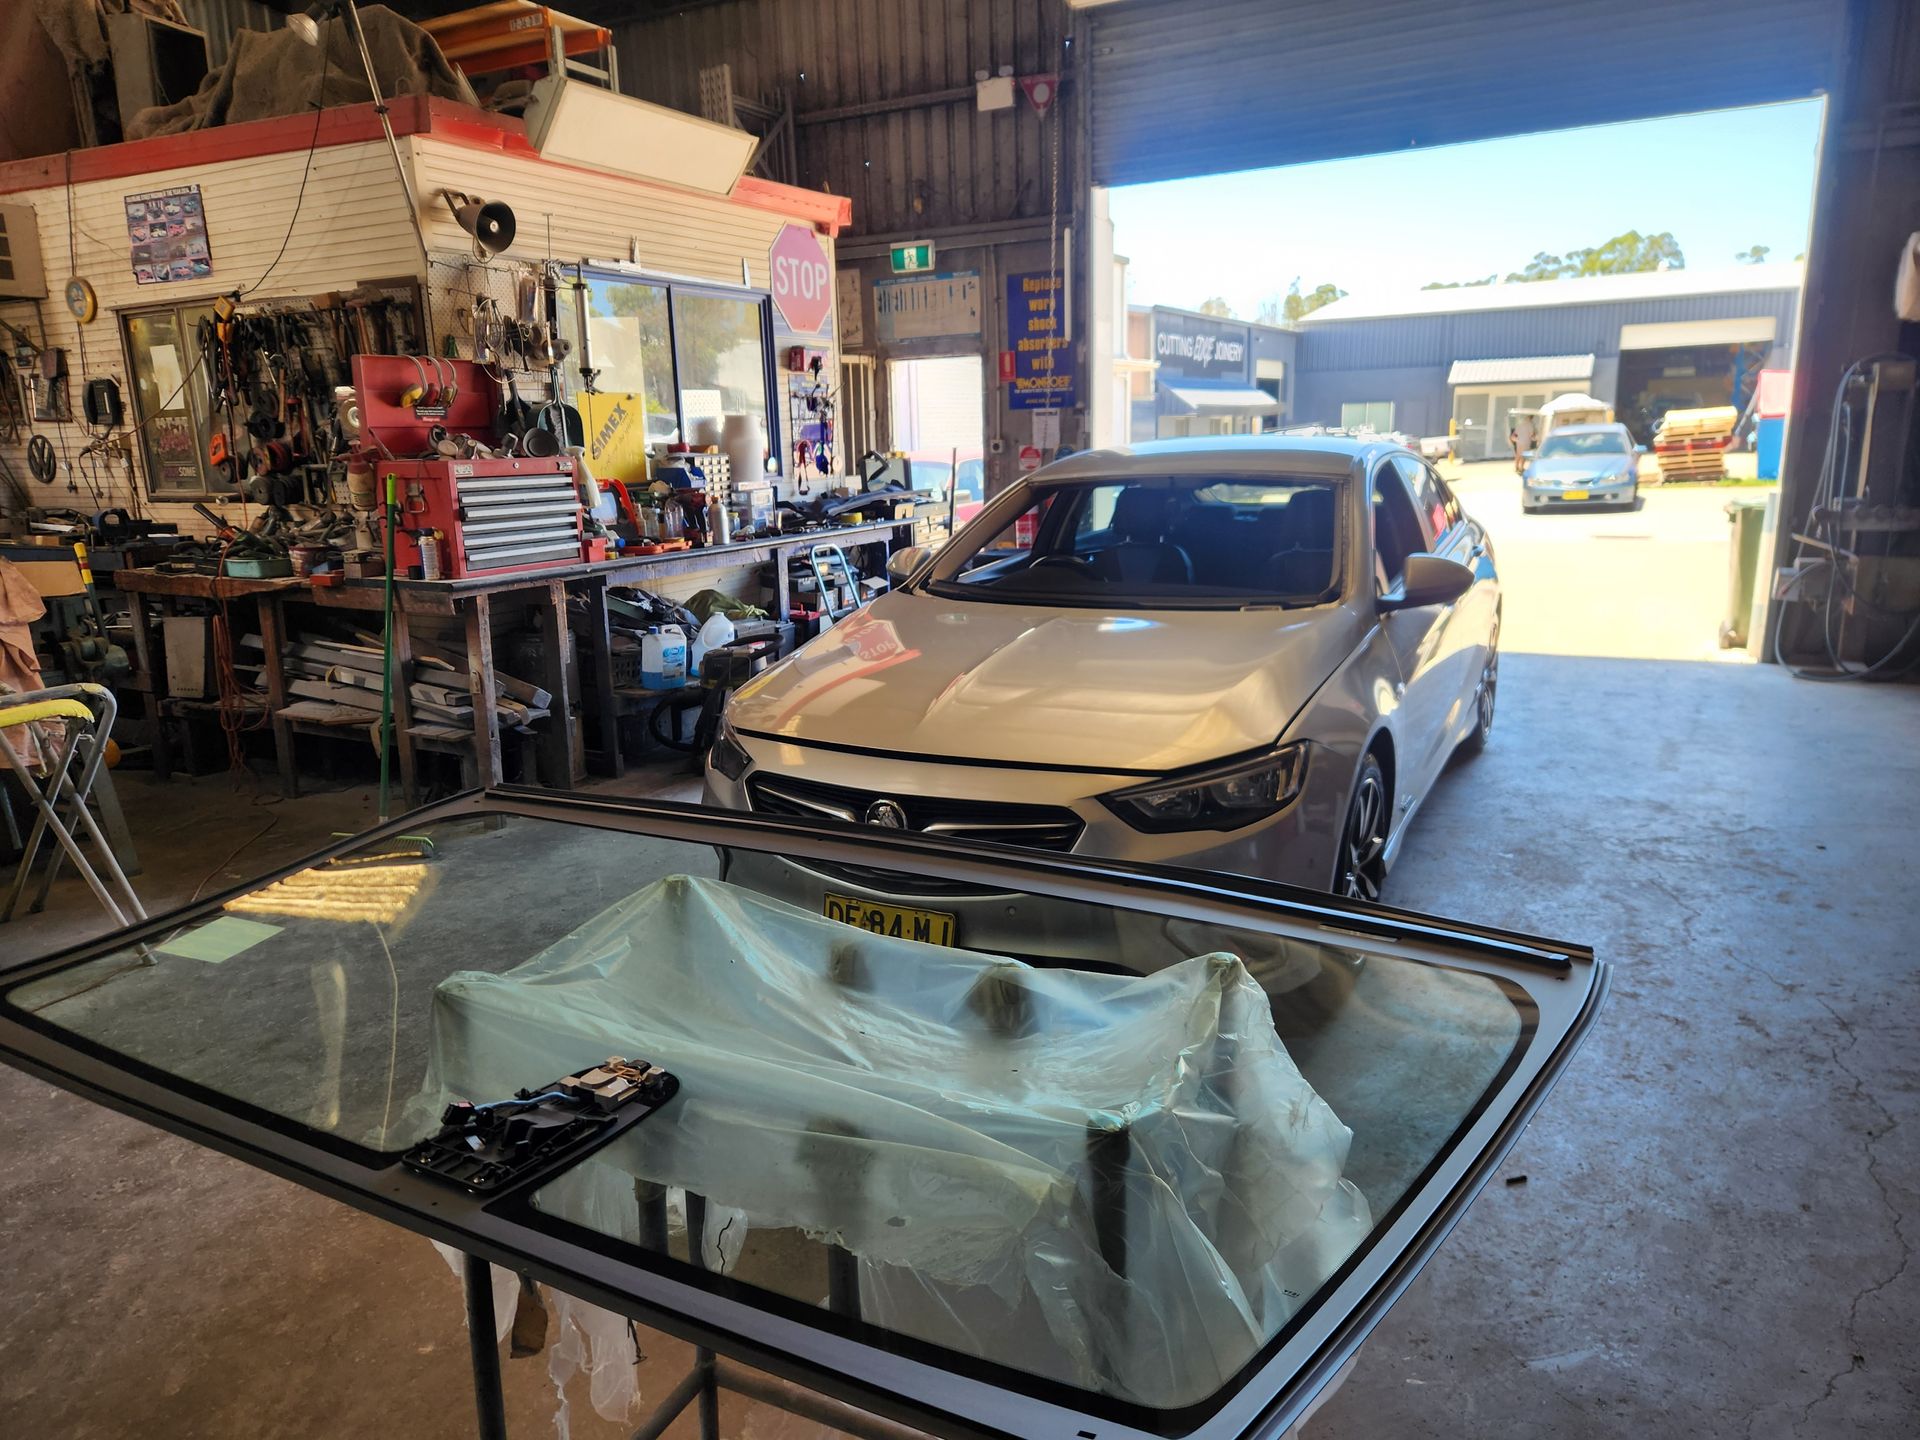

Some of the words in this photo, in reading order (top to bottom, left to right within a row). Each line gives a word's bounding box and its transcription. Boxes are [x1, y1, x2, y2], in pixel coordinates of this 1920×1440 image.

[776, 255, 828, 300] STOP
[1022, 277, 1062, 293] Replace
[1028, 316, 1057, 331] shock
[1157, 332, 1194, 357] CUTTING
[1214, 341, 1244, 362] JOINERY
[1031, 355, 1055, 370] with
[591, 400, 628, 460] SIMEX
